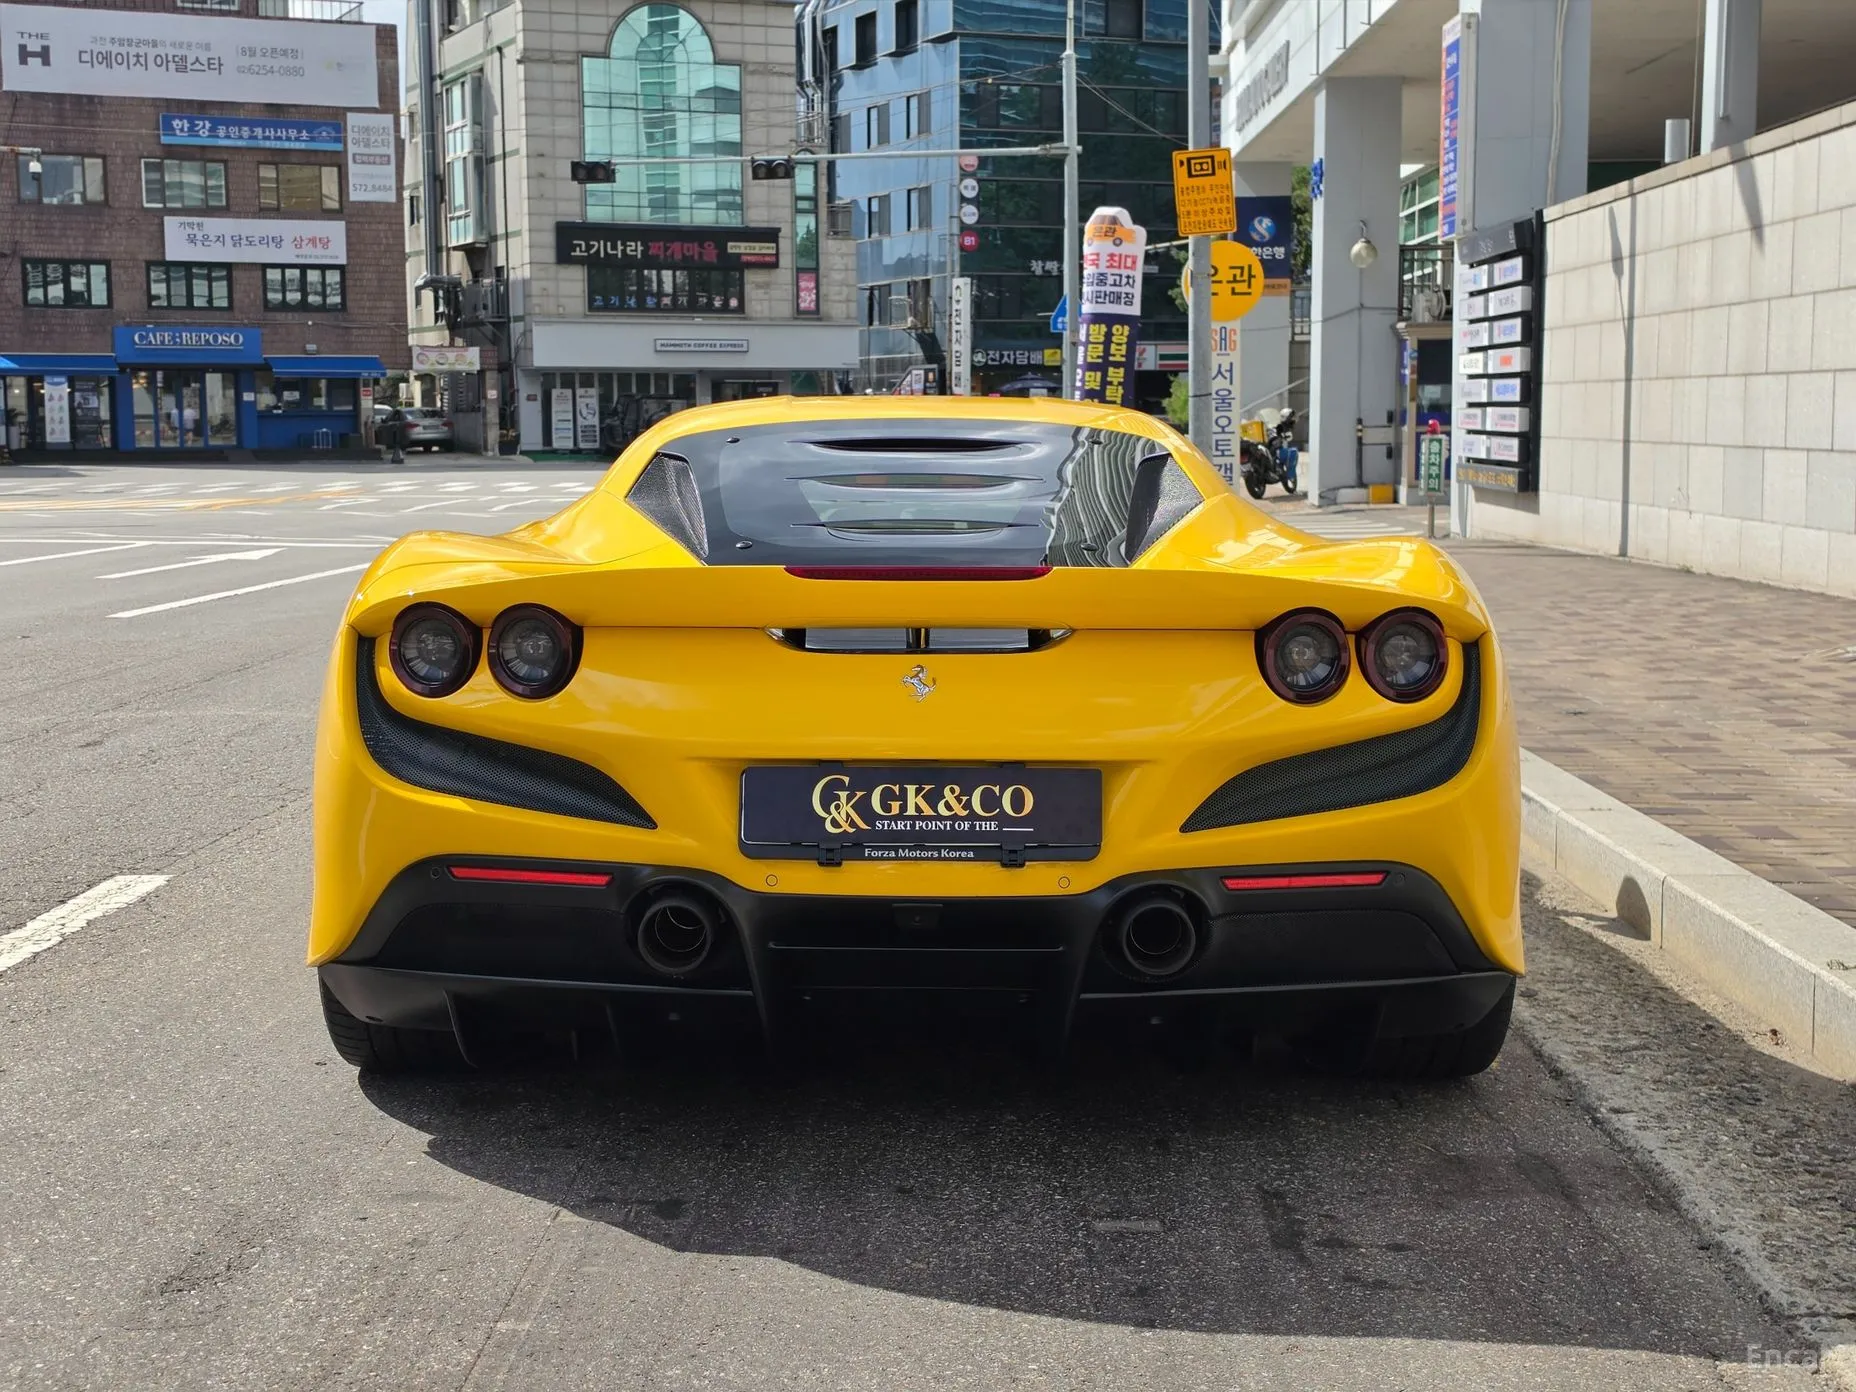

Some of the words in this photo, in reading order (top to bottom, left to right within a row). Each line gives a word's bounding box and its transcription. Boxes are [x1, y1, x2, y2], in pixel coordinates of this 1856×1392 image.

[16, 31, 50, 40] THE
[18, 43, 51, 67] H
[78, 49, 149, 72] 디에이치
[153, 53, 224, 76] 아델스타
[215, 125, 311, 142] 공인중개사사무소
[351, 124, 391, 138] 디에이치
[186, 233, 226, 248] 묵은지
[230, 234, 284, 250] 닭도리탕
[570, 240, 644, 259] 고기나라
[648, 241, 720, 263] 찌개마을
[1251, 246, 1286, 259] 한은행
[1084, 252, 1101, 271] 국
[1105, 252, 1138, 271] 최대
[1084, 272, 1136, 289] 입중고차
[1082, 290, 1135, 307] 시판매장
[693, 341, 717, 349] COFFEE
[1086, 323, 1108, 363] 방문
[1108, 323, 1130, 362] 양보
[1210, 325, 1238, 352] SAG
[987, 350, 1043, 366] 전자담배
[1083, 371, 1102, 391] 및
[871, 784, 1034, 818] GK&CO
[875, 820, 912, 831] START
[916, 821, 953, 831] POINT
[955, 821, 972, 831] OF
[973, 821, 999, 832] THE
[864, 848, 896, 858] Forza
[898, 848, 939, 859] Motors
[941, 848, 974, 859] Korea
